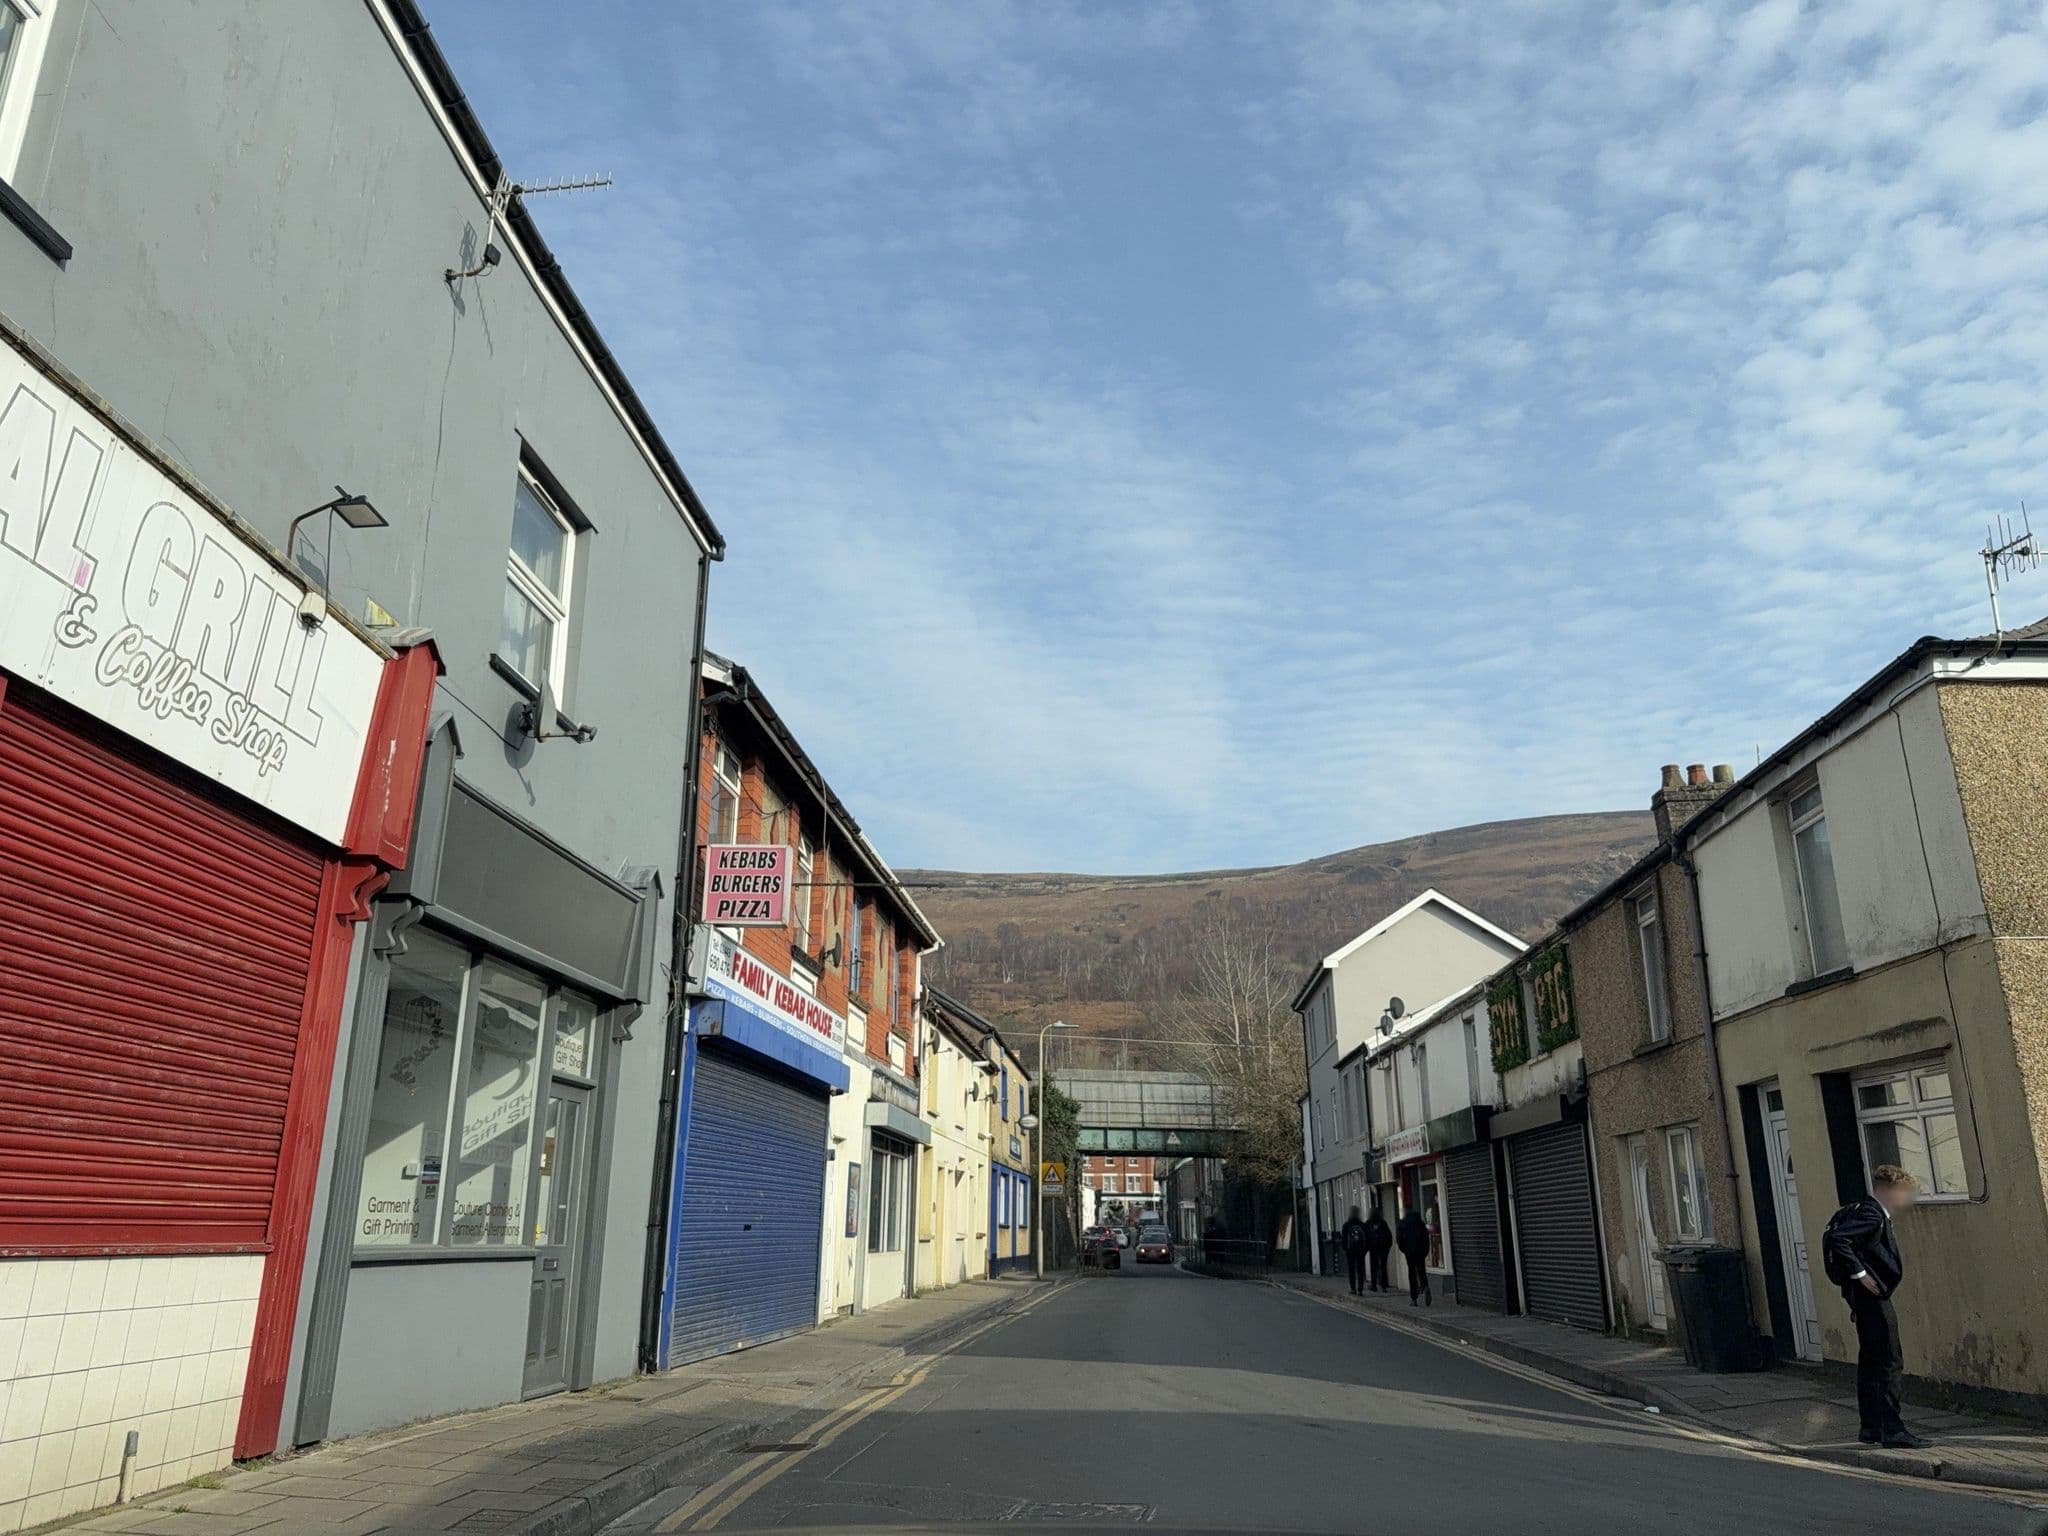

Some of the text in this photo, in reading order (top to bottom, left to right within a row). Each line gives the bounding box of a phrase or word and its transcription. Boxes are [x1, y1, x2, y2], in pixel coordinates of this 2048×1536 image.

[122, 501, 328, 748] GRILL
[54, 593, 288, 777] & Coffee Shop
[719, 851, 777, 868] KEBABS
[711, 875, 781, 893] BURGERS
[717, 900, 771, 918] PIZZA
[706, 981, 726, 999] PIZZA
[731, 949, 834, 1039] FAMILY KEBAB HOUSE
[554, 1050, 568, 1065] Gift
[367, 1196, 420, 1214] Garment &
[362, 1218, 420, 1238] Gift Printing
